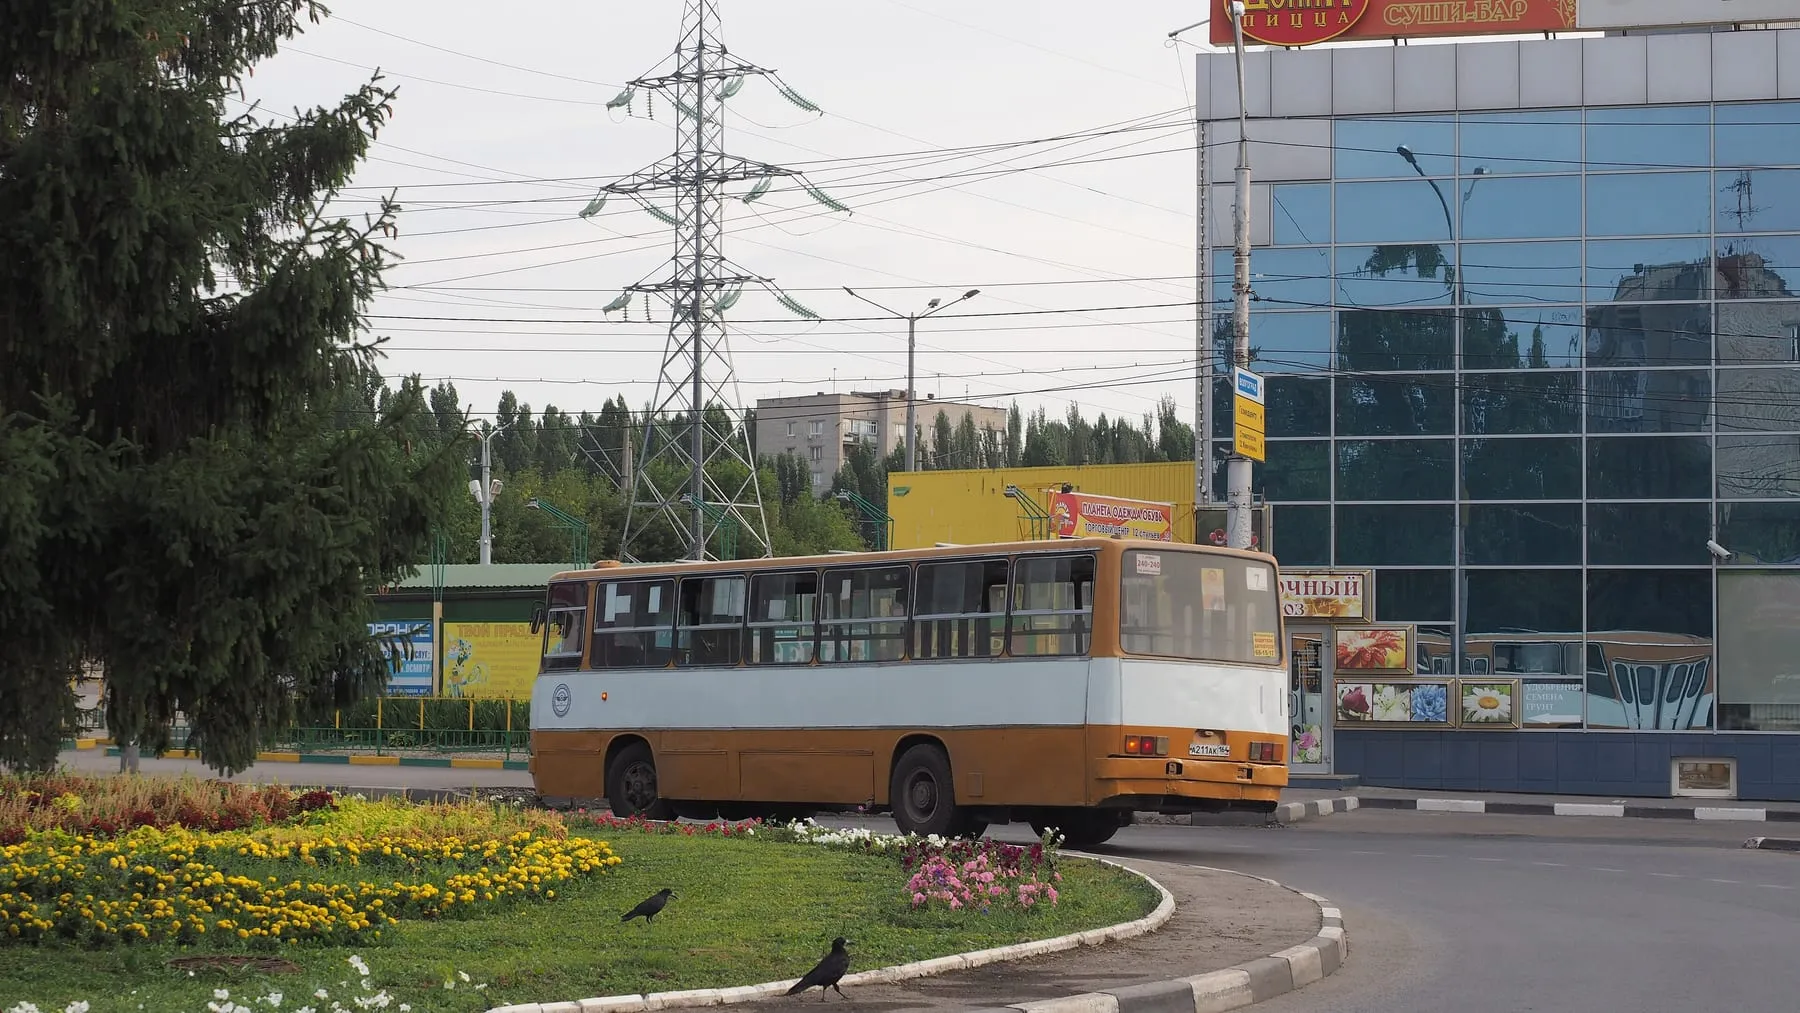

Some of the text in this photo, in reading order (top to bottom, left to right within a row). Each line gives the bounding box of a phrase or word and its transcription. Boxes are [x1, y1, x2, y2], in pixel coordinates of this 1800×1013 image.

[1243, 11, 1349, 28] ПИЦЦА
[1384, 0, 1527, 25] СУШИ-БАР
[1082, 502, 1112, 517] ПЛАНЕТА
[1113, 506, 1141, 520] ОДЕЖДА
[1142, 509, 1162, 522] ОБУВЬ
[1525, 693, 1563, 701] СЕМЕНА
[1526, 703, 1553, 711] ГРУНТ
